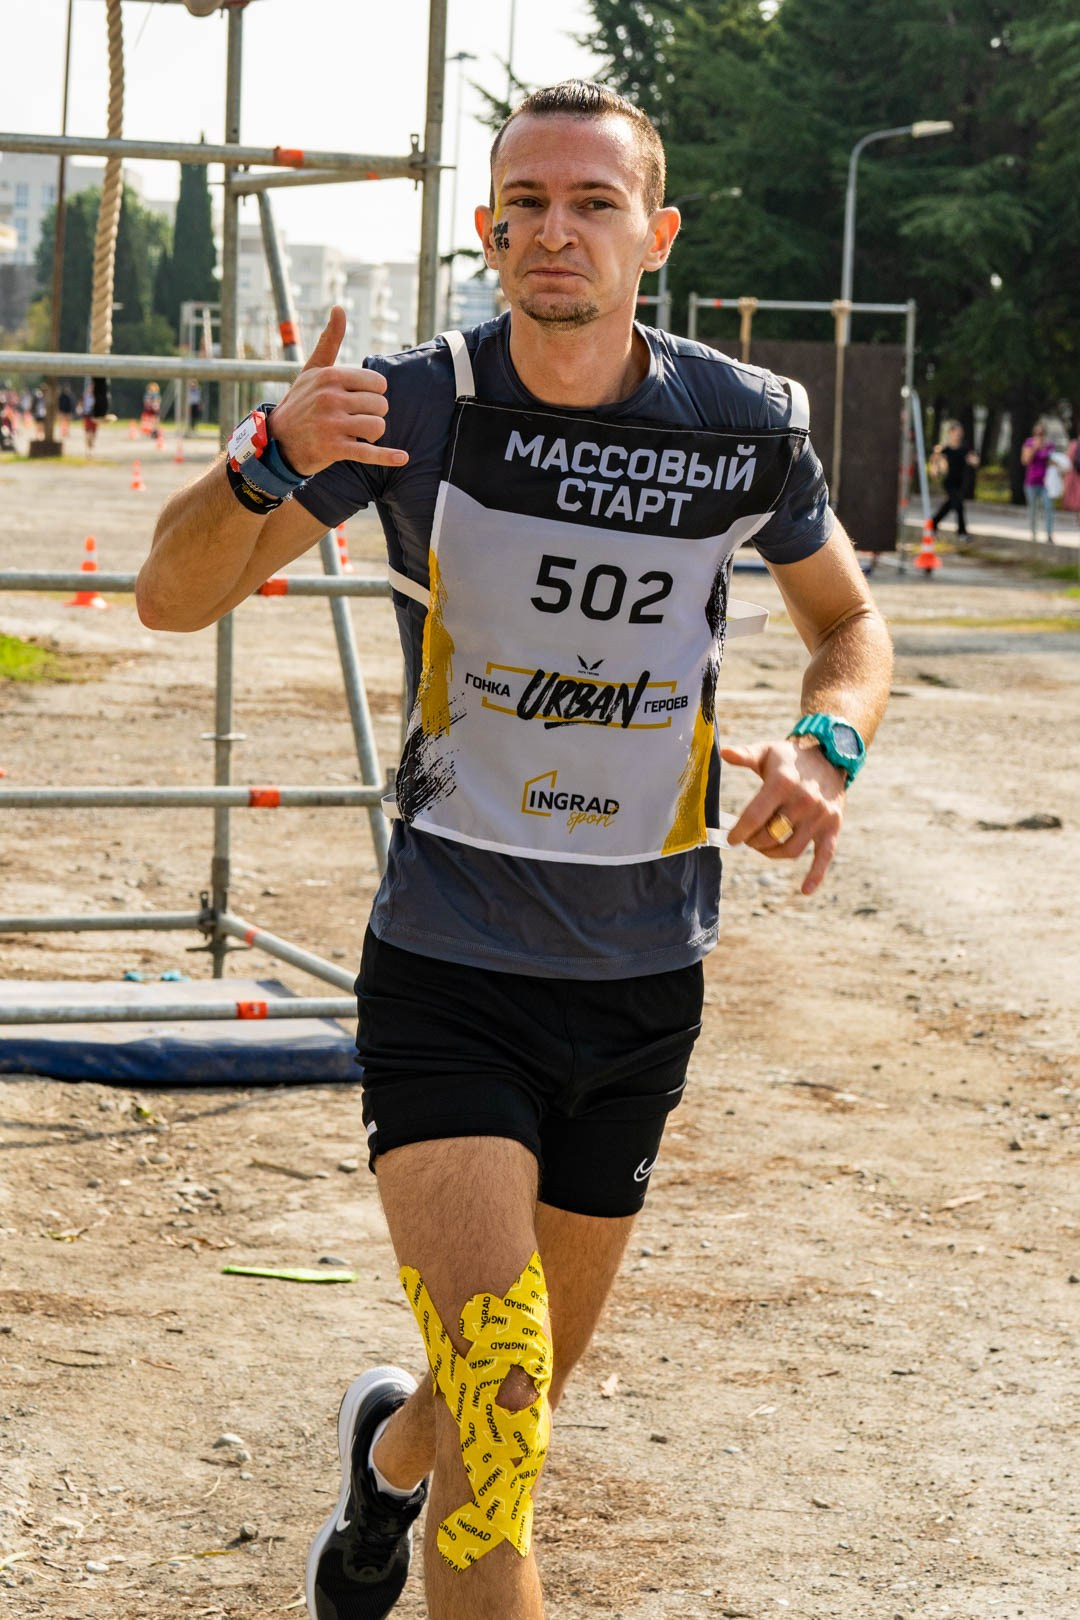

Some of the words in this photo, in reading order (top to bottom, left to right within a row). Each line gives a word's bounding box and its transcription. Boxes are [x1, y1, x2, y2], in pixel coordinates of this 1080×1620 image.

[504, 430, 758, 492] МАССОВЫЙ
[556, 477, 693, 527] СТАРТ
[530, 554, 674, 625] 502
[465, 672, 511, 698] ГОНКА
[516, 669, 651, 729] URBAN
[643, 694, 689, 714] ГЕРОЕВ
[529, 790, 620, 815] INGRAD
[566, 804, 621, 834] sport
[504, 1298, 534, 1315] INGRAD
[490, 1341, 528, 1352] INGRAD
[455, 1382, 467, 1423] INGRAD
[486, 1403, 503, 1442] INGRAD
[478, 1467, 503, 1497] INGRAD
[457, 1518, 492, 1541] INGRAD
